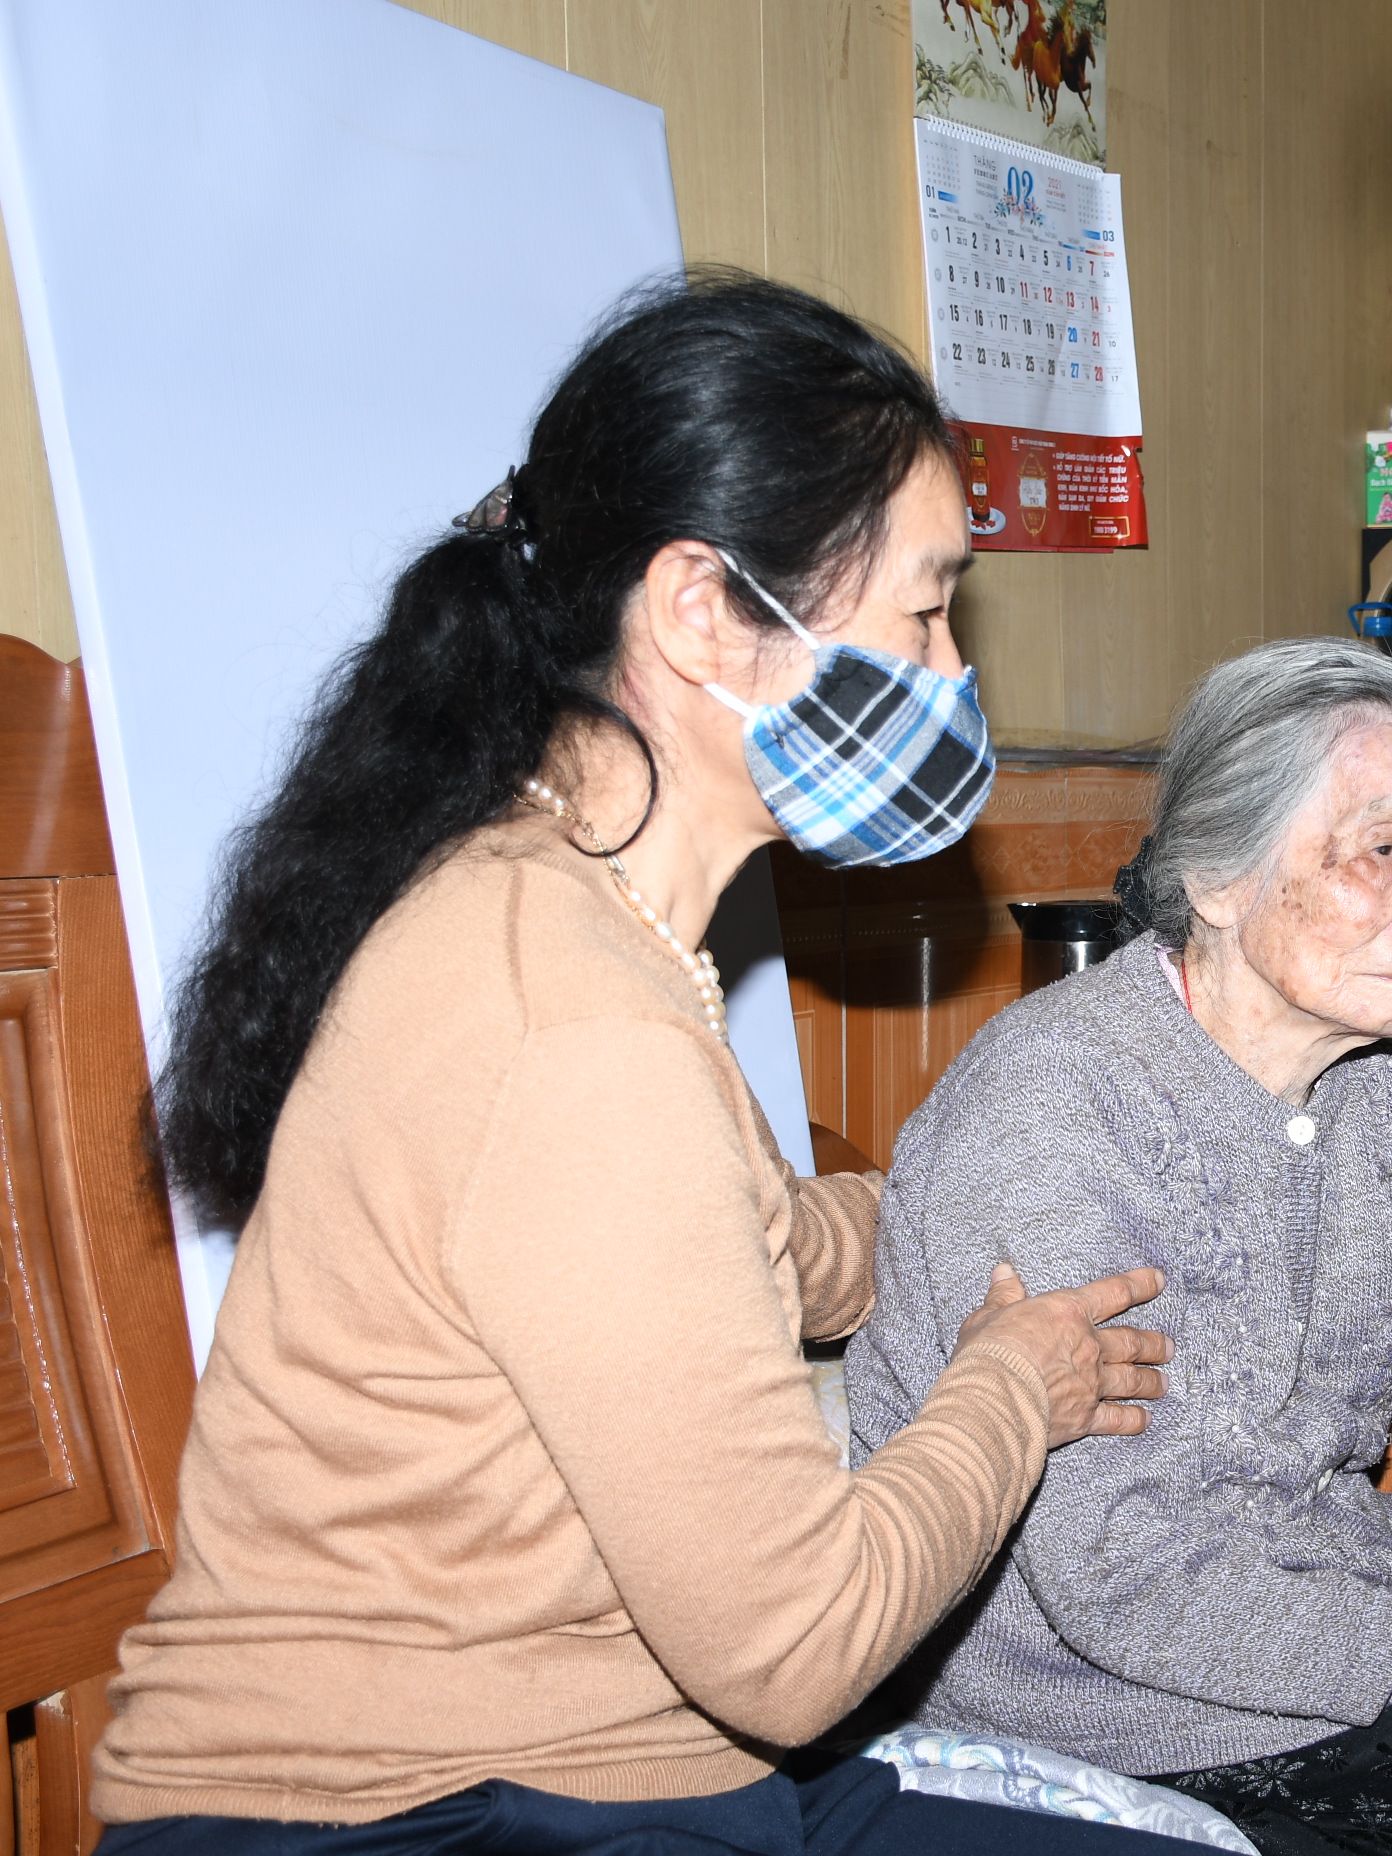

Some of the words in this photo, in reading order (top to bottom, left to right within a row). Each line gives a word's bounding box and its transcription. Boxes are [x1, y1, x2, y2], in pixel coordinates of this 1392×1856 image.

[973, 154, 997, 172] THÁNG
[926, 184, 935, 199] 01
[1007, 166, 1034, 209] 02
[1047, 177, 1062, 190] 2021
[1102, 230, 1115, 242] 03
[945, 225, 950, 243] 1
[972, 231, 977, 250] 2
[995, 238, 1001, 255] 3
[1019, 244, 1025, 261] 4
[1043, 250, 1049, 267] 5
[1066, 255, 1071, 272] 6
[1089, 260, 1094, 276] 7
[1103, 270, 1110, 278] 26
[949, 265, 954, 283] 8
[974, 270, 980, 288] 9
[995, 276, 1005, 294] 10
[1020, 281, 1028, 299] 11
[1043, 286, 1053, 303] 12
[1066, 291, 1075, 308] 13
[1090, 296, 1099, 312] 14
[949, 303, 960, 322] 15
[975, 309, 984, 327] 16
[999, 314, 1008, 331] 17
[1023, 318, 1032, 335] 18
[1046, 323, 1054, 340] 19
[1068, 327, 1078, 343] 20
[1092, 331, 1100, 347] 21
[1108, 340, 1117, 348] 10
[952, 343, 962, 361] 22
[977, 347, 986, 365] 23
[1001, 351, 1011, 369] 24
[1026, 355, 1035, 372] 25
[1048, 359, 1056, 376] 26
[1070, 362, 1079, 379] 27
[1094, 366, 1103, 382] 28
[1108, 494, 1129, 503] CHỨC
